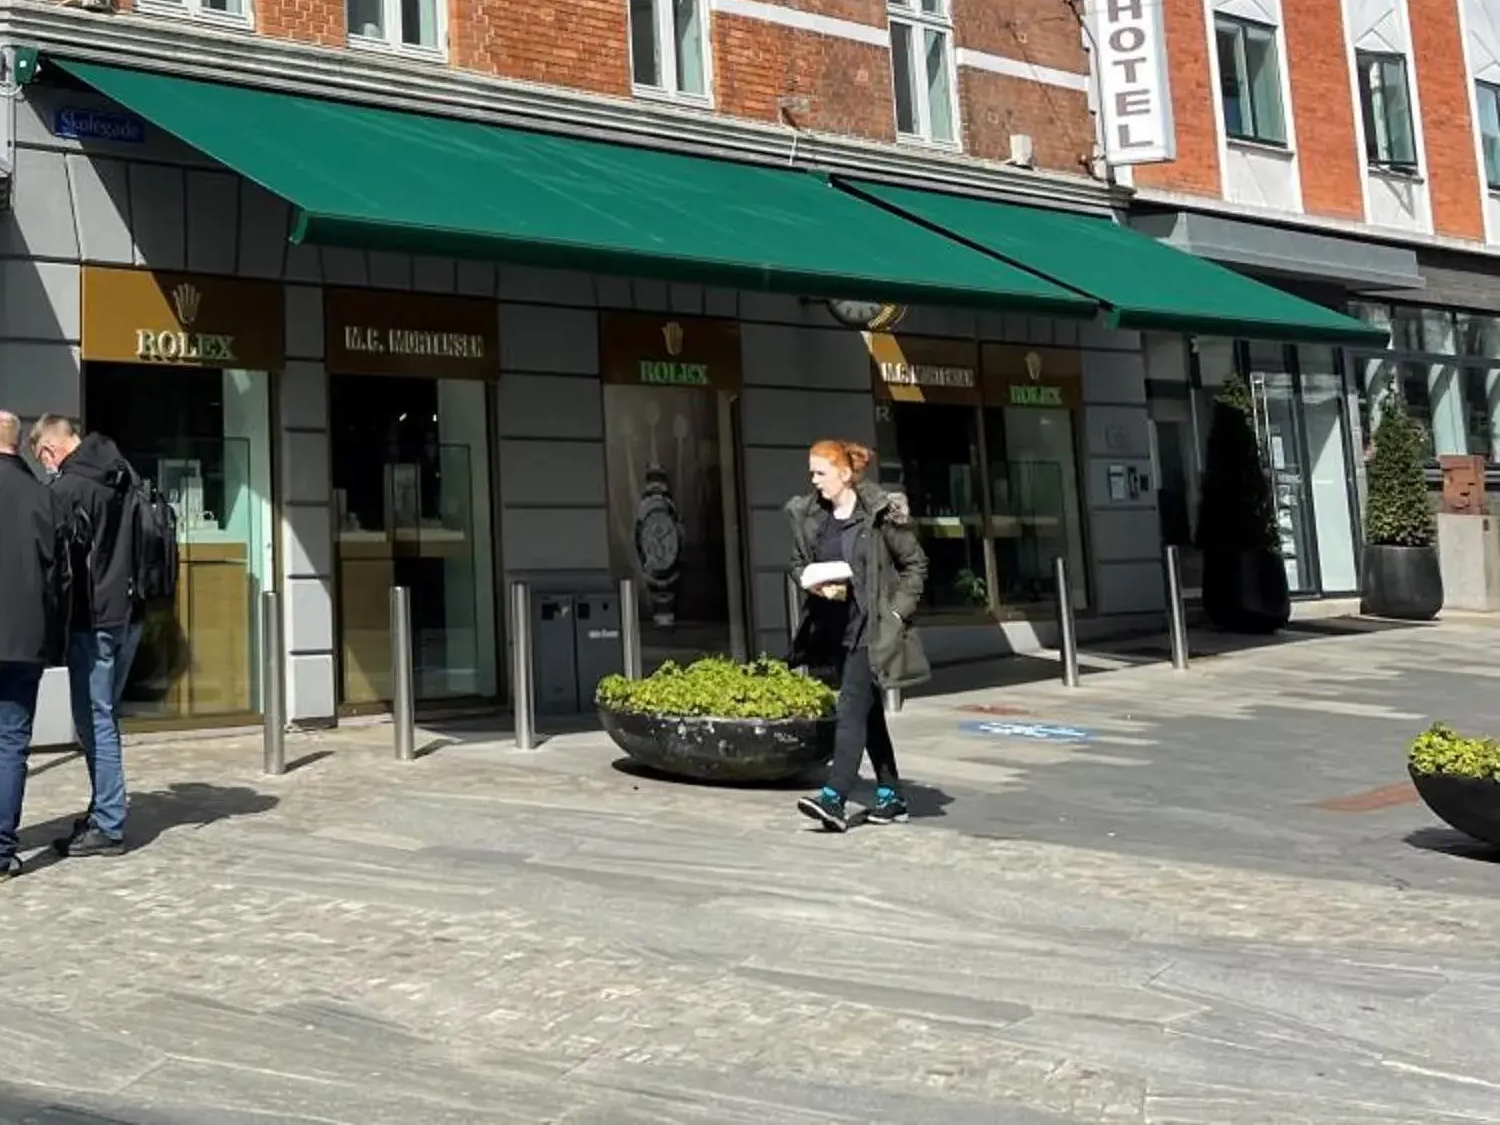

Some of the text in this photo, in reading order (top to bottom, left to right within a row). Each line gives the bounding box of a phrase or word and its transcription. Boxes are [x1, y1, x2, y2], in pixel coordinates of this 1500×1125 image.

[135, 328, 237, 360] ROLEX
[344, 325, 485, 359] M.C. MORTENSEN
[638, 360, 711, 386] ROLEX
[1009, 385, 1063, 405] ROLEX
